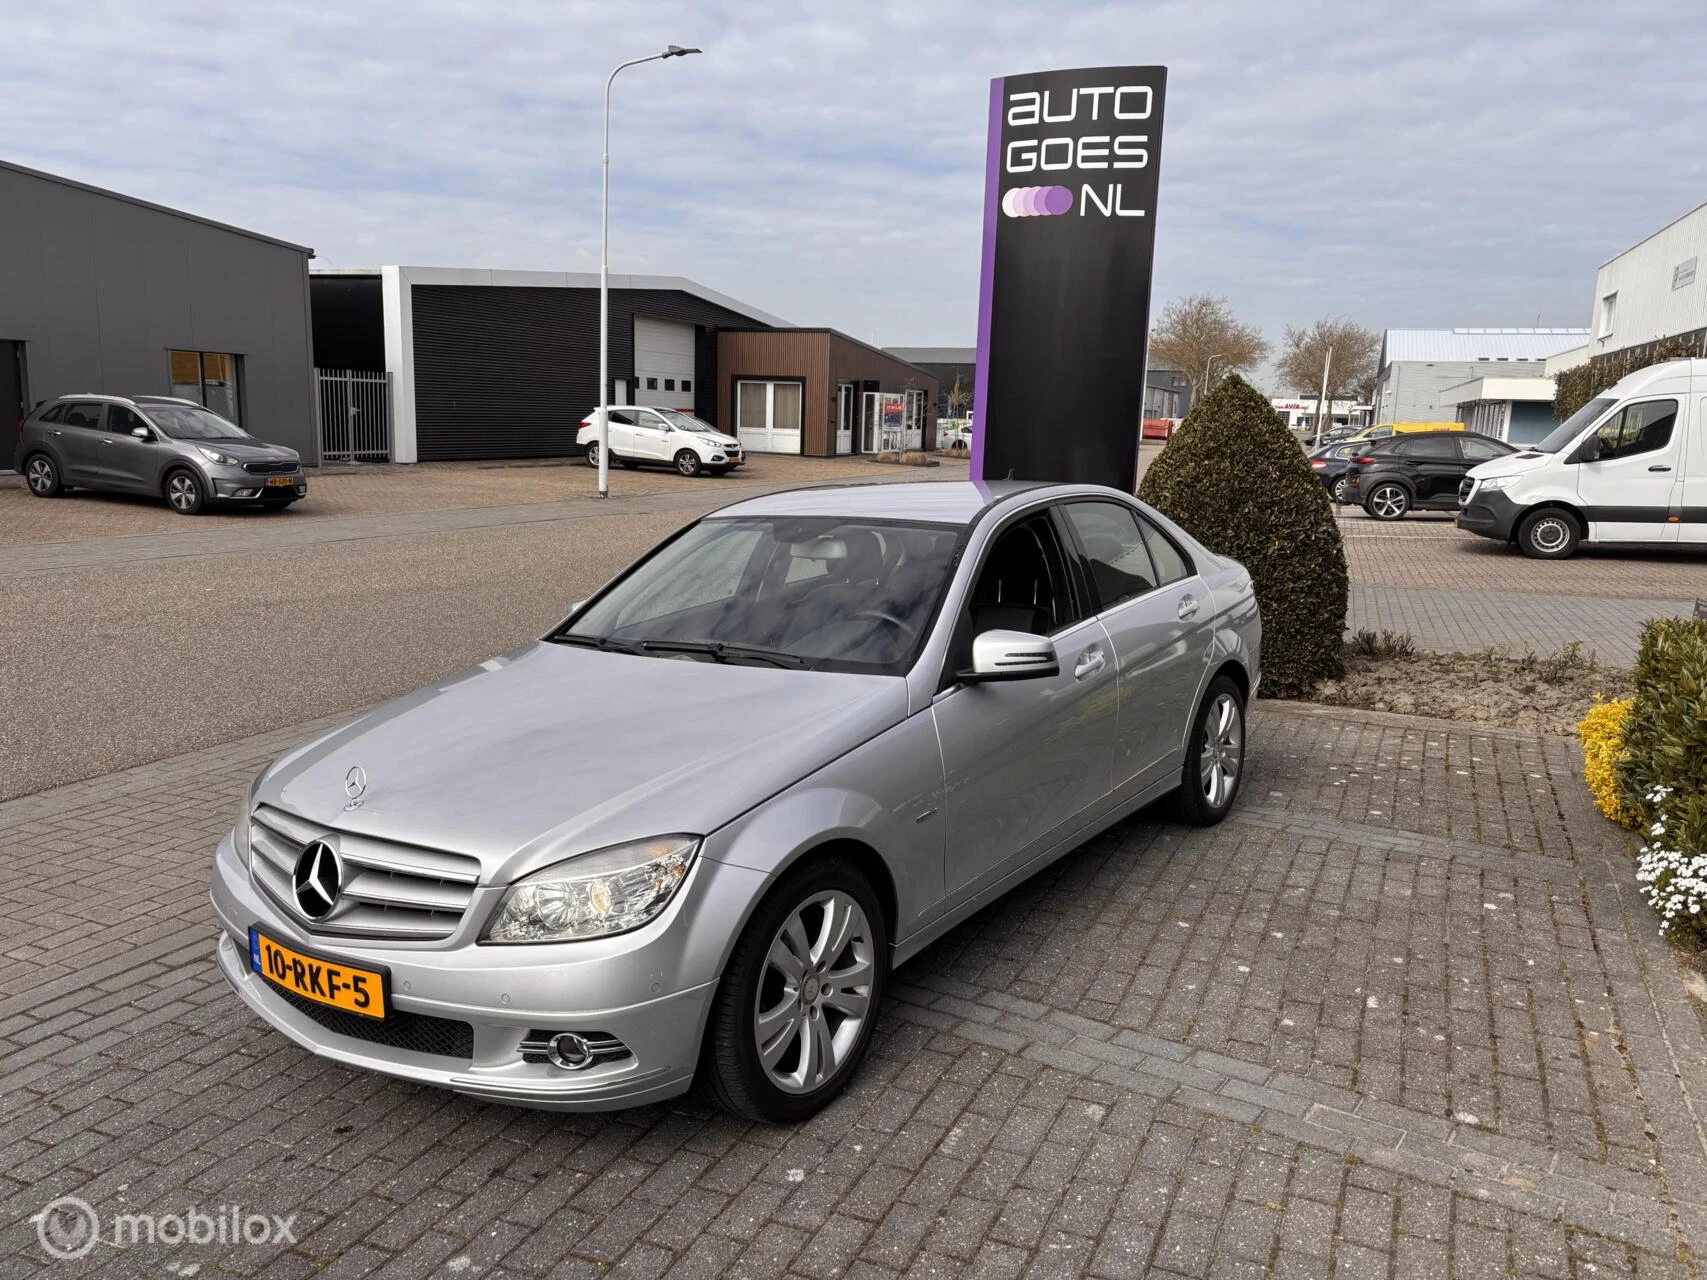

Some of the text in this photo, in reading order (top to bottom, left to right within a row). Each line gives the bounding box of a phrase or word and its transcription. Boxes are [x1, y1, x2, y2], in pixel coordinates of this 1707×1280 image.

[1006, 135, 1149, 173] GOES
[1079, 183, 1146, 217] NL
[265, 944, 370, 1008] 10-RKF-5
